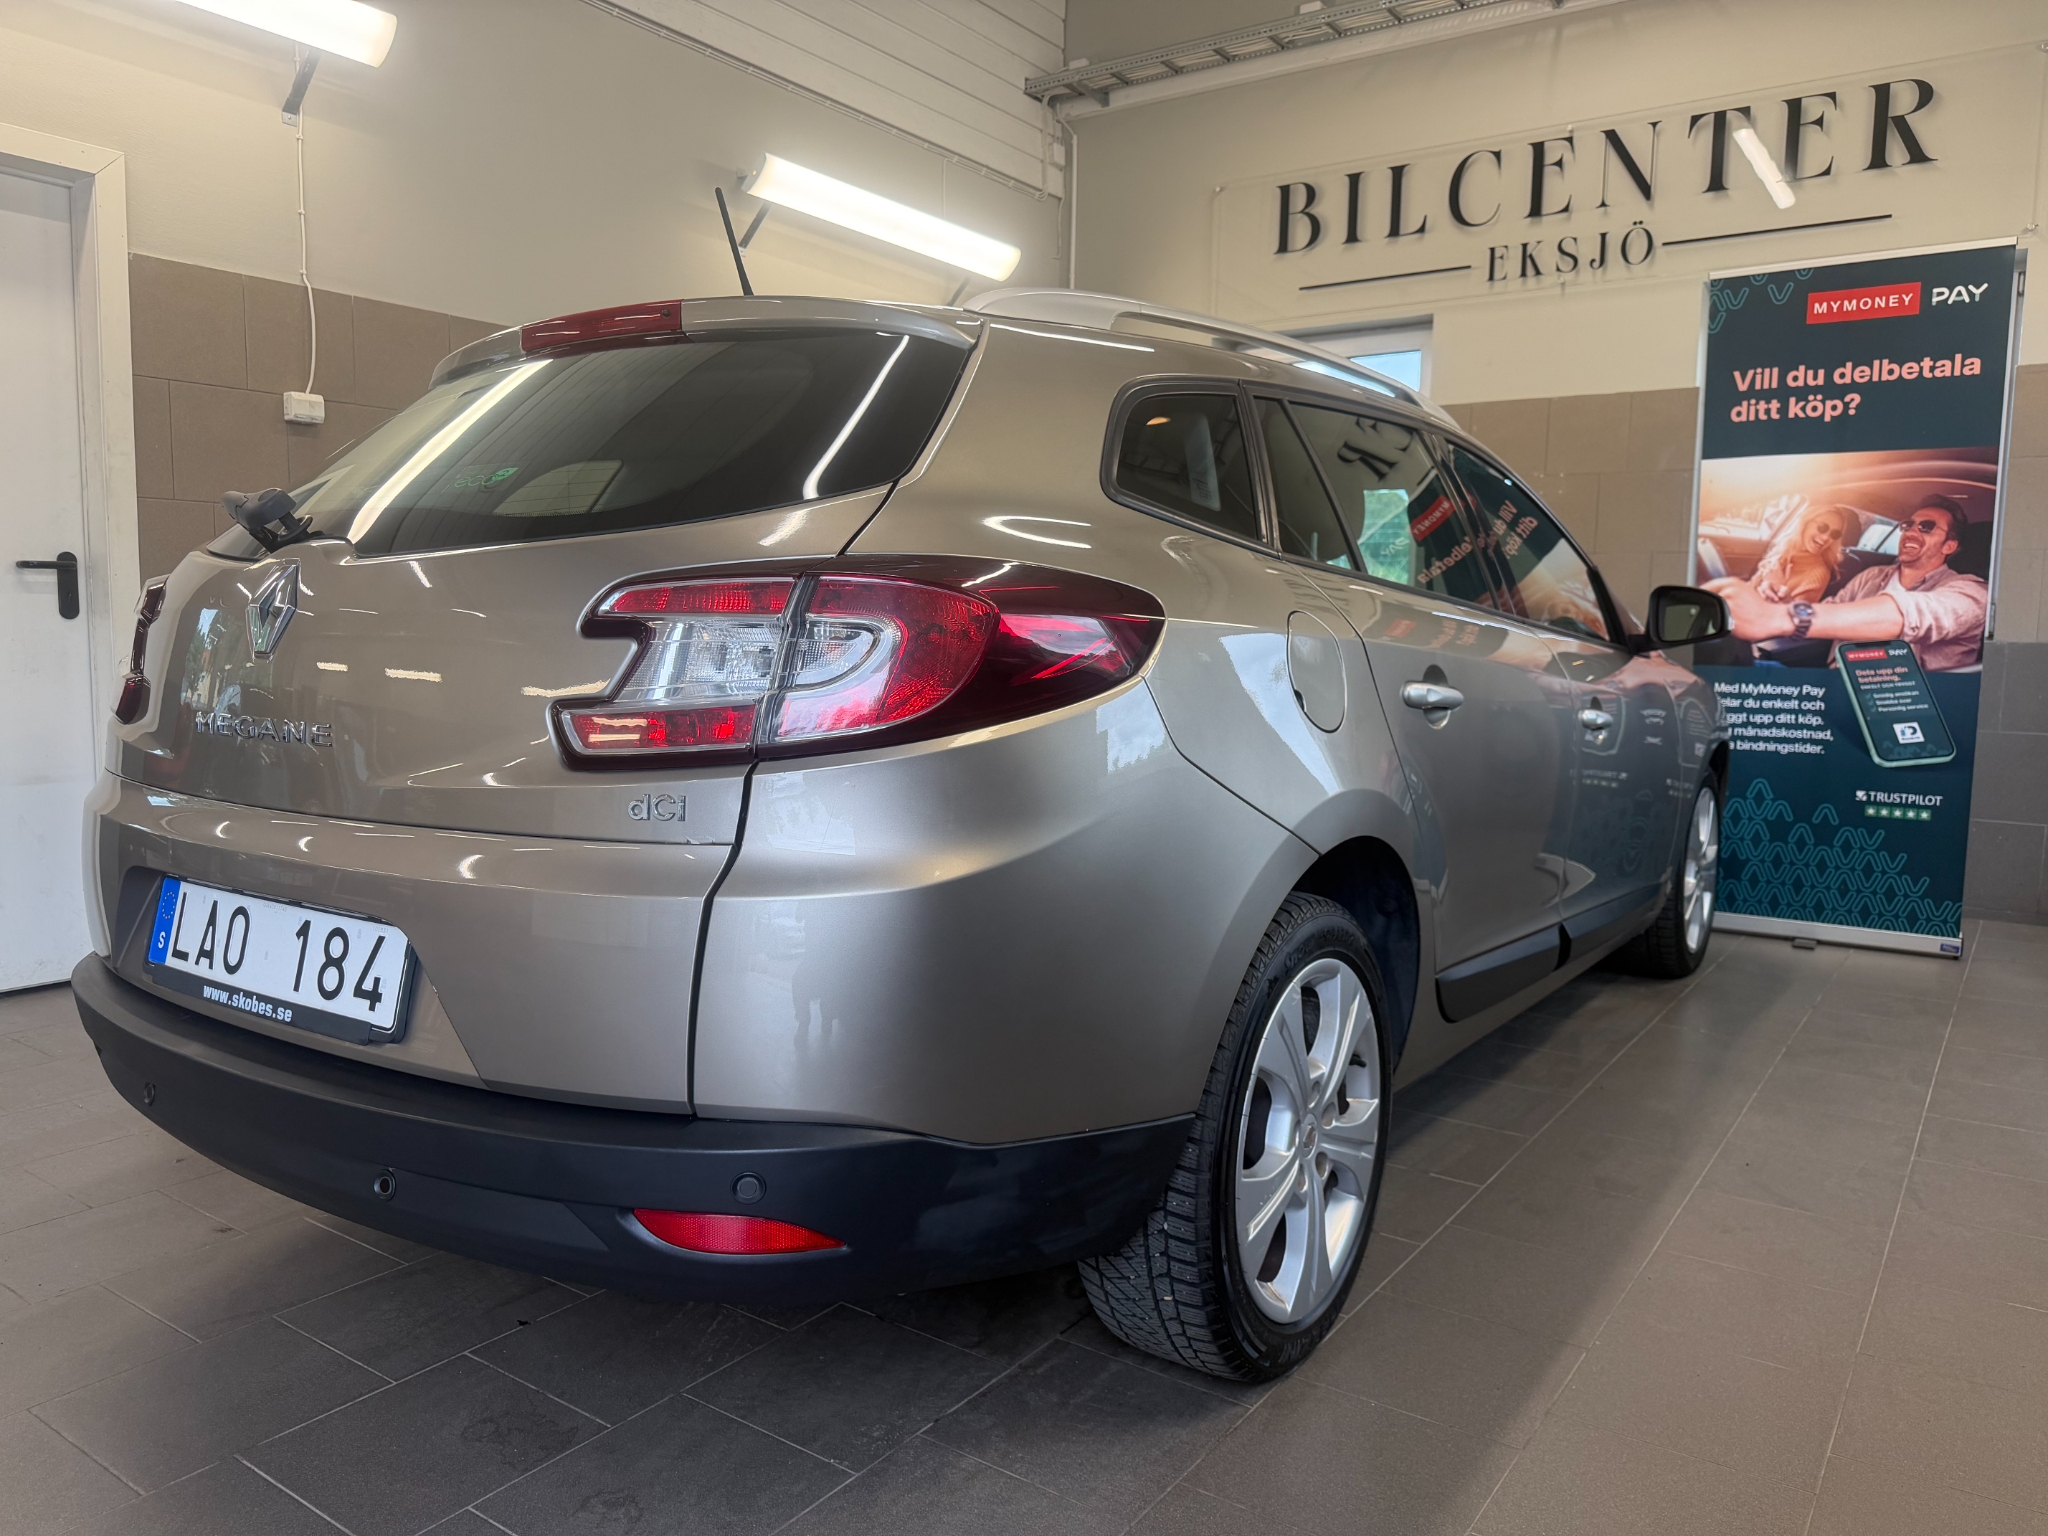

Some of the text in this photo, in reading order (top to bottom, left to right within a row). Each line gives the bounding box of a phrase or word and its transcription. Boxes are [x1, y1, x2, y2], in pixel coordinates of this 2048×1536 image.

[1274, 76, 1940, 256] BILCENTER
[1486, 218, 1654, 284] EKSJÖ
[1813, 282, 1989, 315] MYMONEY PAY
[1732, 353, 1982, 392] Vill du delbetala
[1730, 392, 1862, 423] ditt köp?
[1713, 681, 1826, 698] Med MyMoney Pay
[1743, 697, 1760, 709] du
[1761, 698, 1799, 710] enkelt
[1801, 699, 1825, 711] och
[196, 711, 333, 747] MEGANE
[1734, 726, 1834, 742] månadskostnad,
[1749, 714, 1774, 725] upp
[1775, 712, 1797, 724] ditt
[1798, 713, 1825, 727] köp.
[1736, 740, 1826, 755] bindningstider.
[628, 794, 687, 822] dCi
[1868, 790, 1943, 807] TRUSTPILOT
[157, 931, 166, 949] S
[171, 891, 386, 1013] LAO 184
[203, 985, 293, 1023] www.skobes.se
